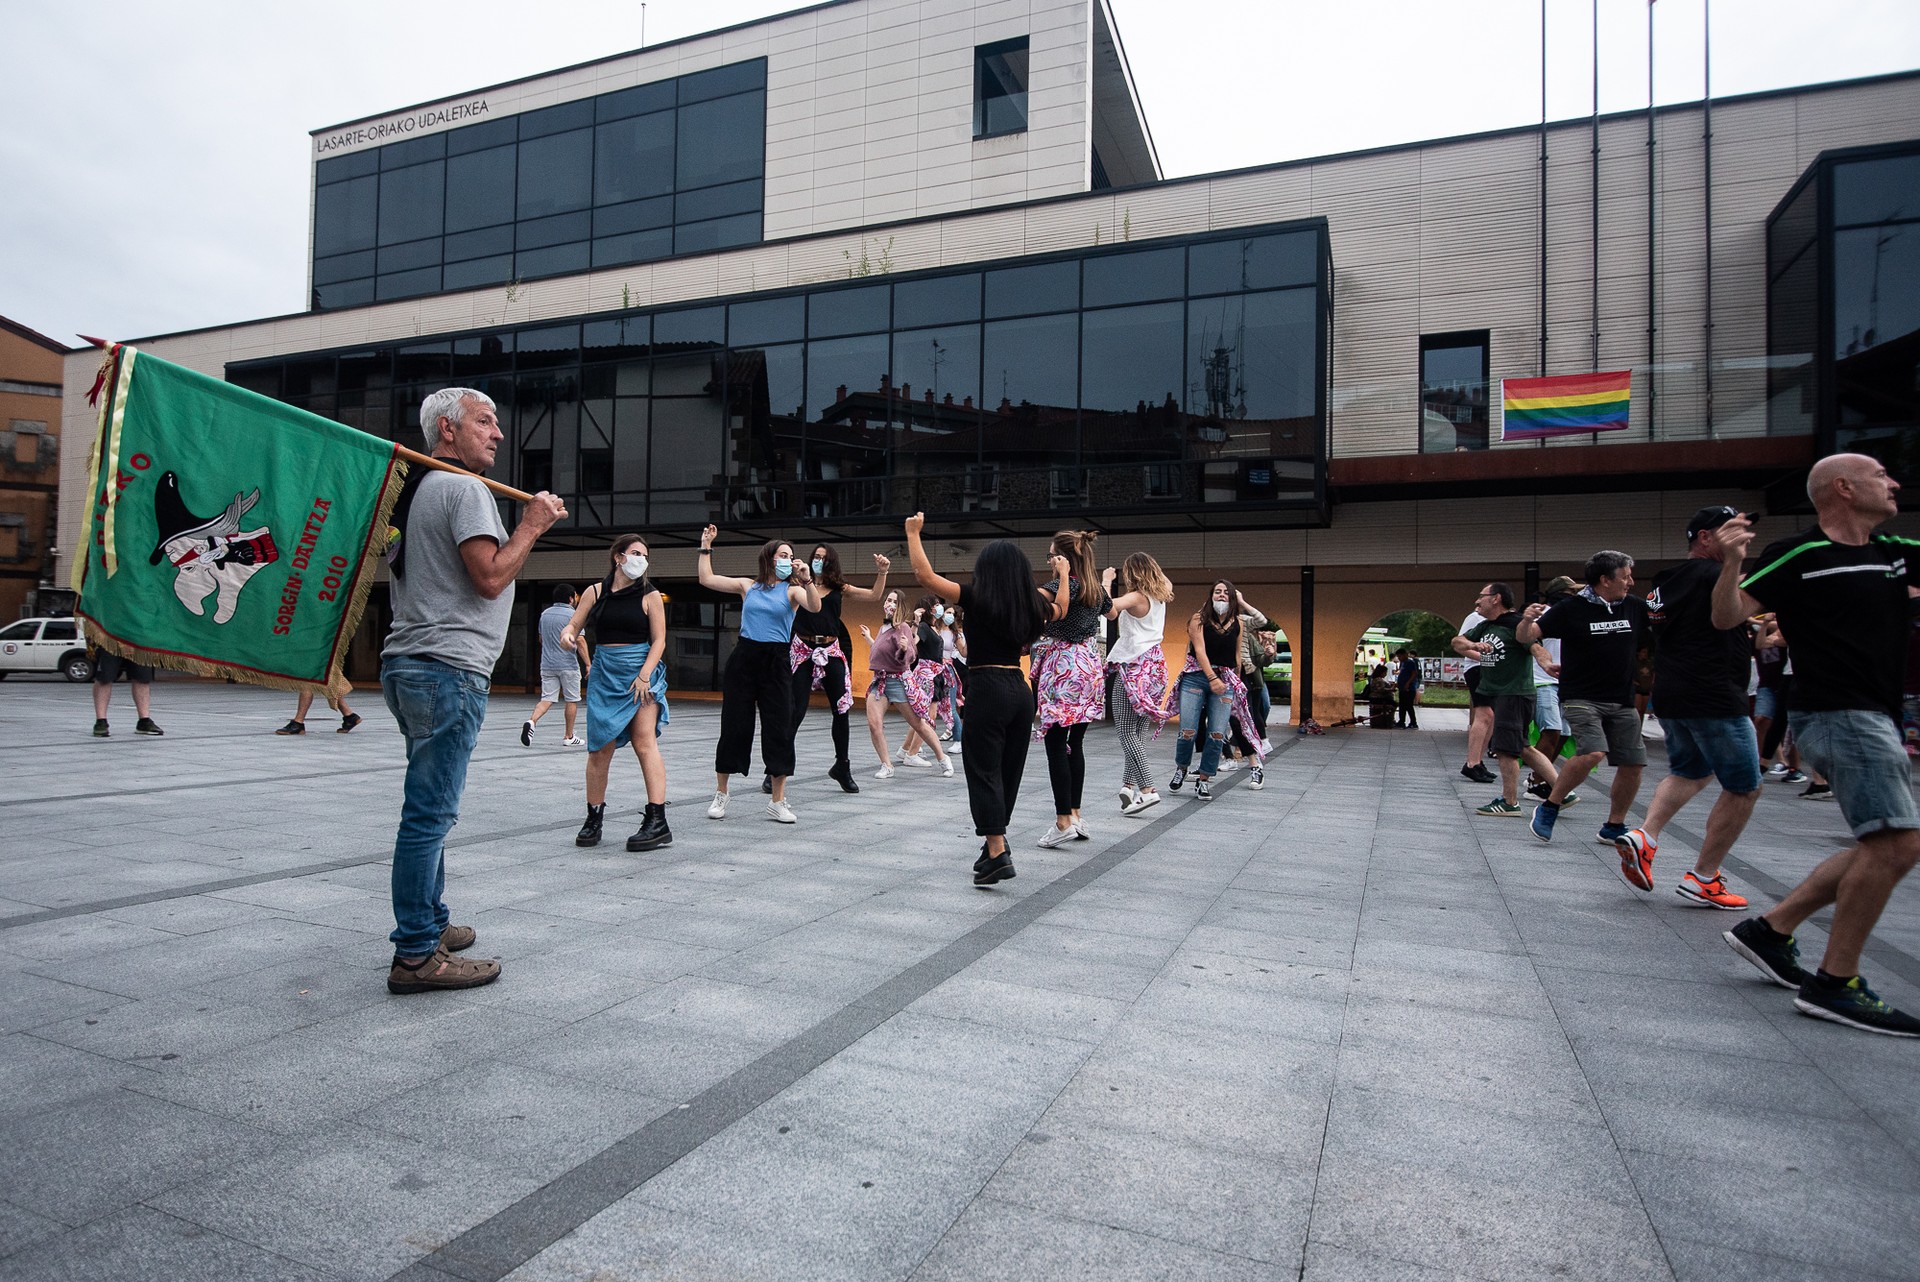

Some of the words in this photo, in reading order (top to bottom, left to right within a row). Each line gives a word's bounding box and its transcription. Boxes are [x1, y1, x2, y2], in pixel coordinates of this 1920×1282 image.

[317, 119, 416, 153] LASARTE-ORIAKO
[418, 100, 489, 128] UDALETXEA
[319, 556, 348, 602] 2010
